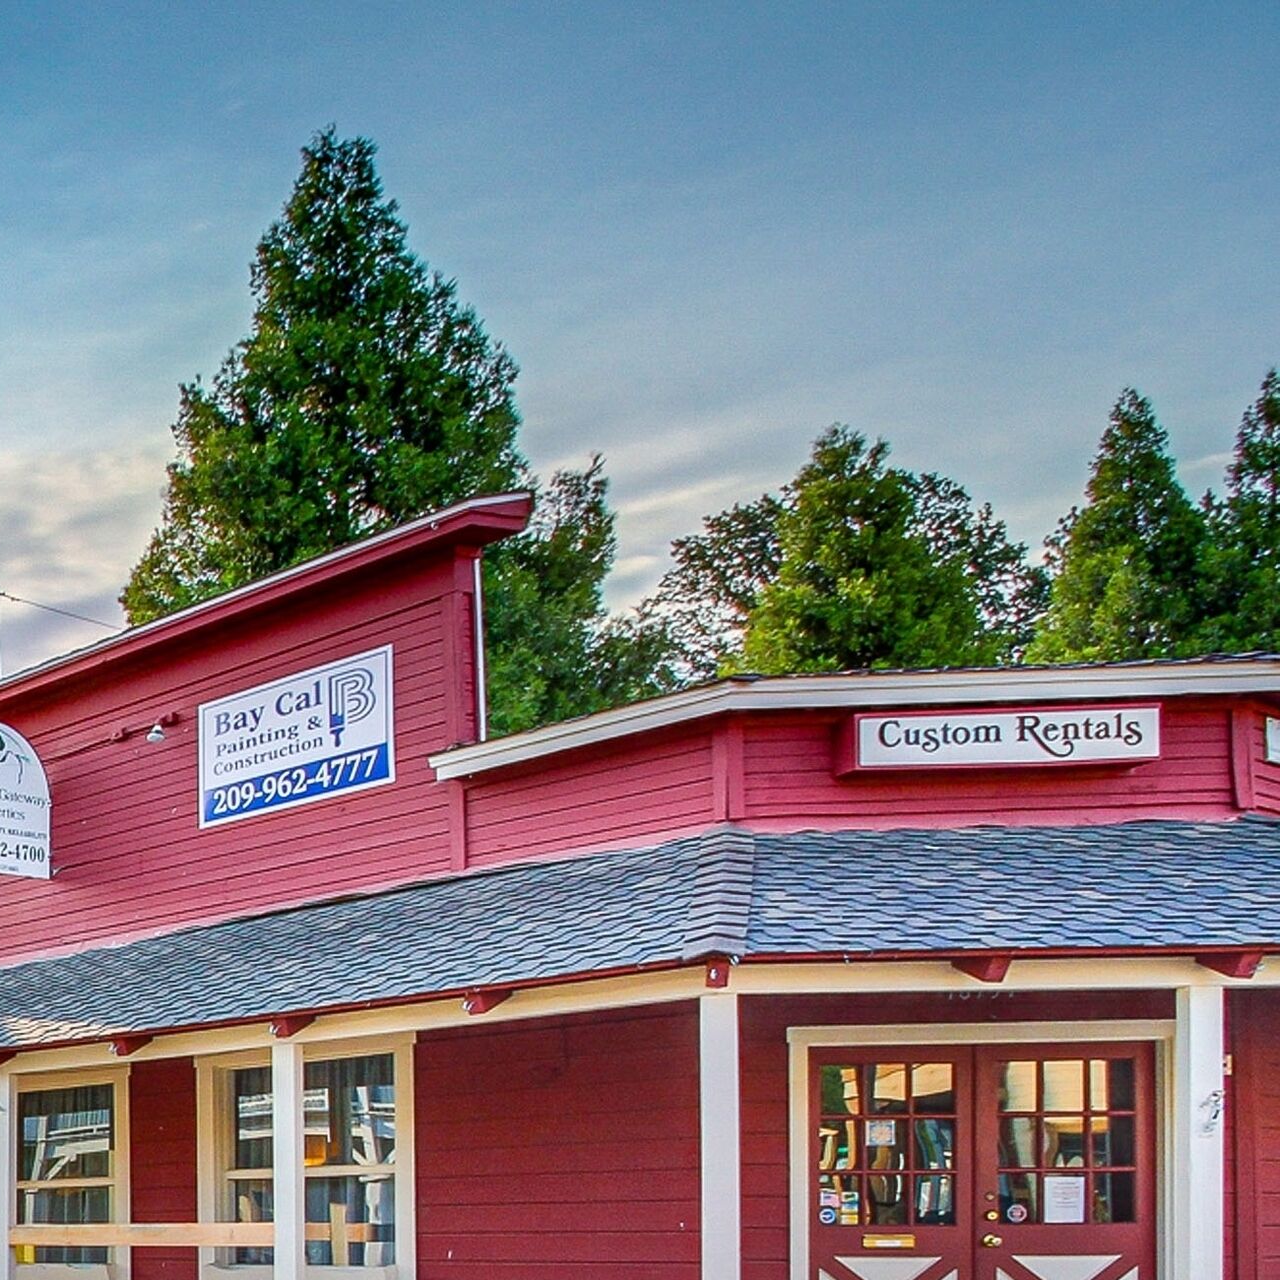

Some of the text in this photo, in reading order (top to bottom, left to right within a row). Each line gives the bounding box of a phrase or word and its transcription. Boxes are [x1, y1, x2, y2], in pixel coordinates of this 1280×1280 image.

[214, 679, 324, 738] Bay Cal
[213, 735, 324, 777] Construction
[215, 715, 324, 758] Painting &
[878, 713, 1143, 757] Custom Rentals
[213, 749, 379, 815] 209-962-4777
